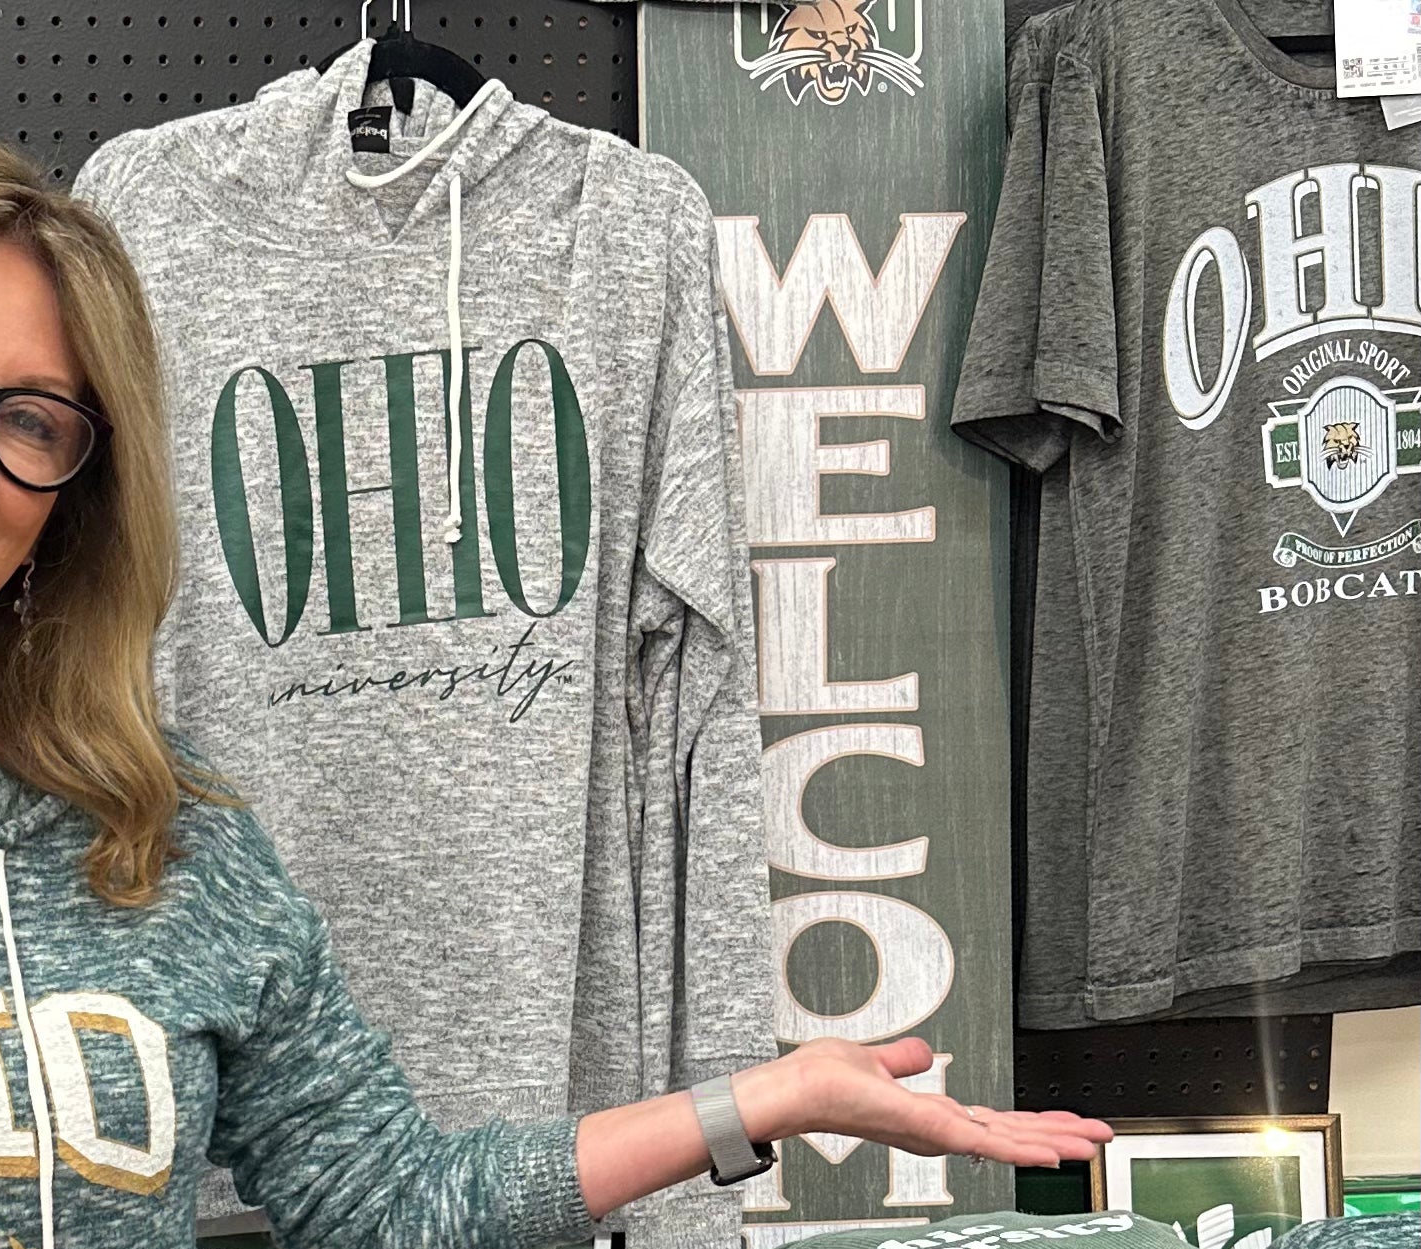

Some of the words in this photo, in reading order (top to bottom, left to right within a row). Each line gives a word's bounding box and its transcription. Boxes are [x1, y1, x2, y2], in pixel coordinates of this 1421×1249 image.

[1282, 339, 1355, 395] ORIGINAL
[1356, 341, 1411, 386] SPORT
[1276, 442, 1301, 463] EST.
[1397, 429, 1421, 450] 1804
[211, 338, 592, 648] OHIO
[1295, 539, 1323, 558] PROOF
[1324, 552, 1335, 563] OF
[1337, 526, 1414, 564] PERFECTION
[1257, 570, 1421, 614] BOBCAT
